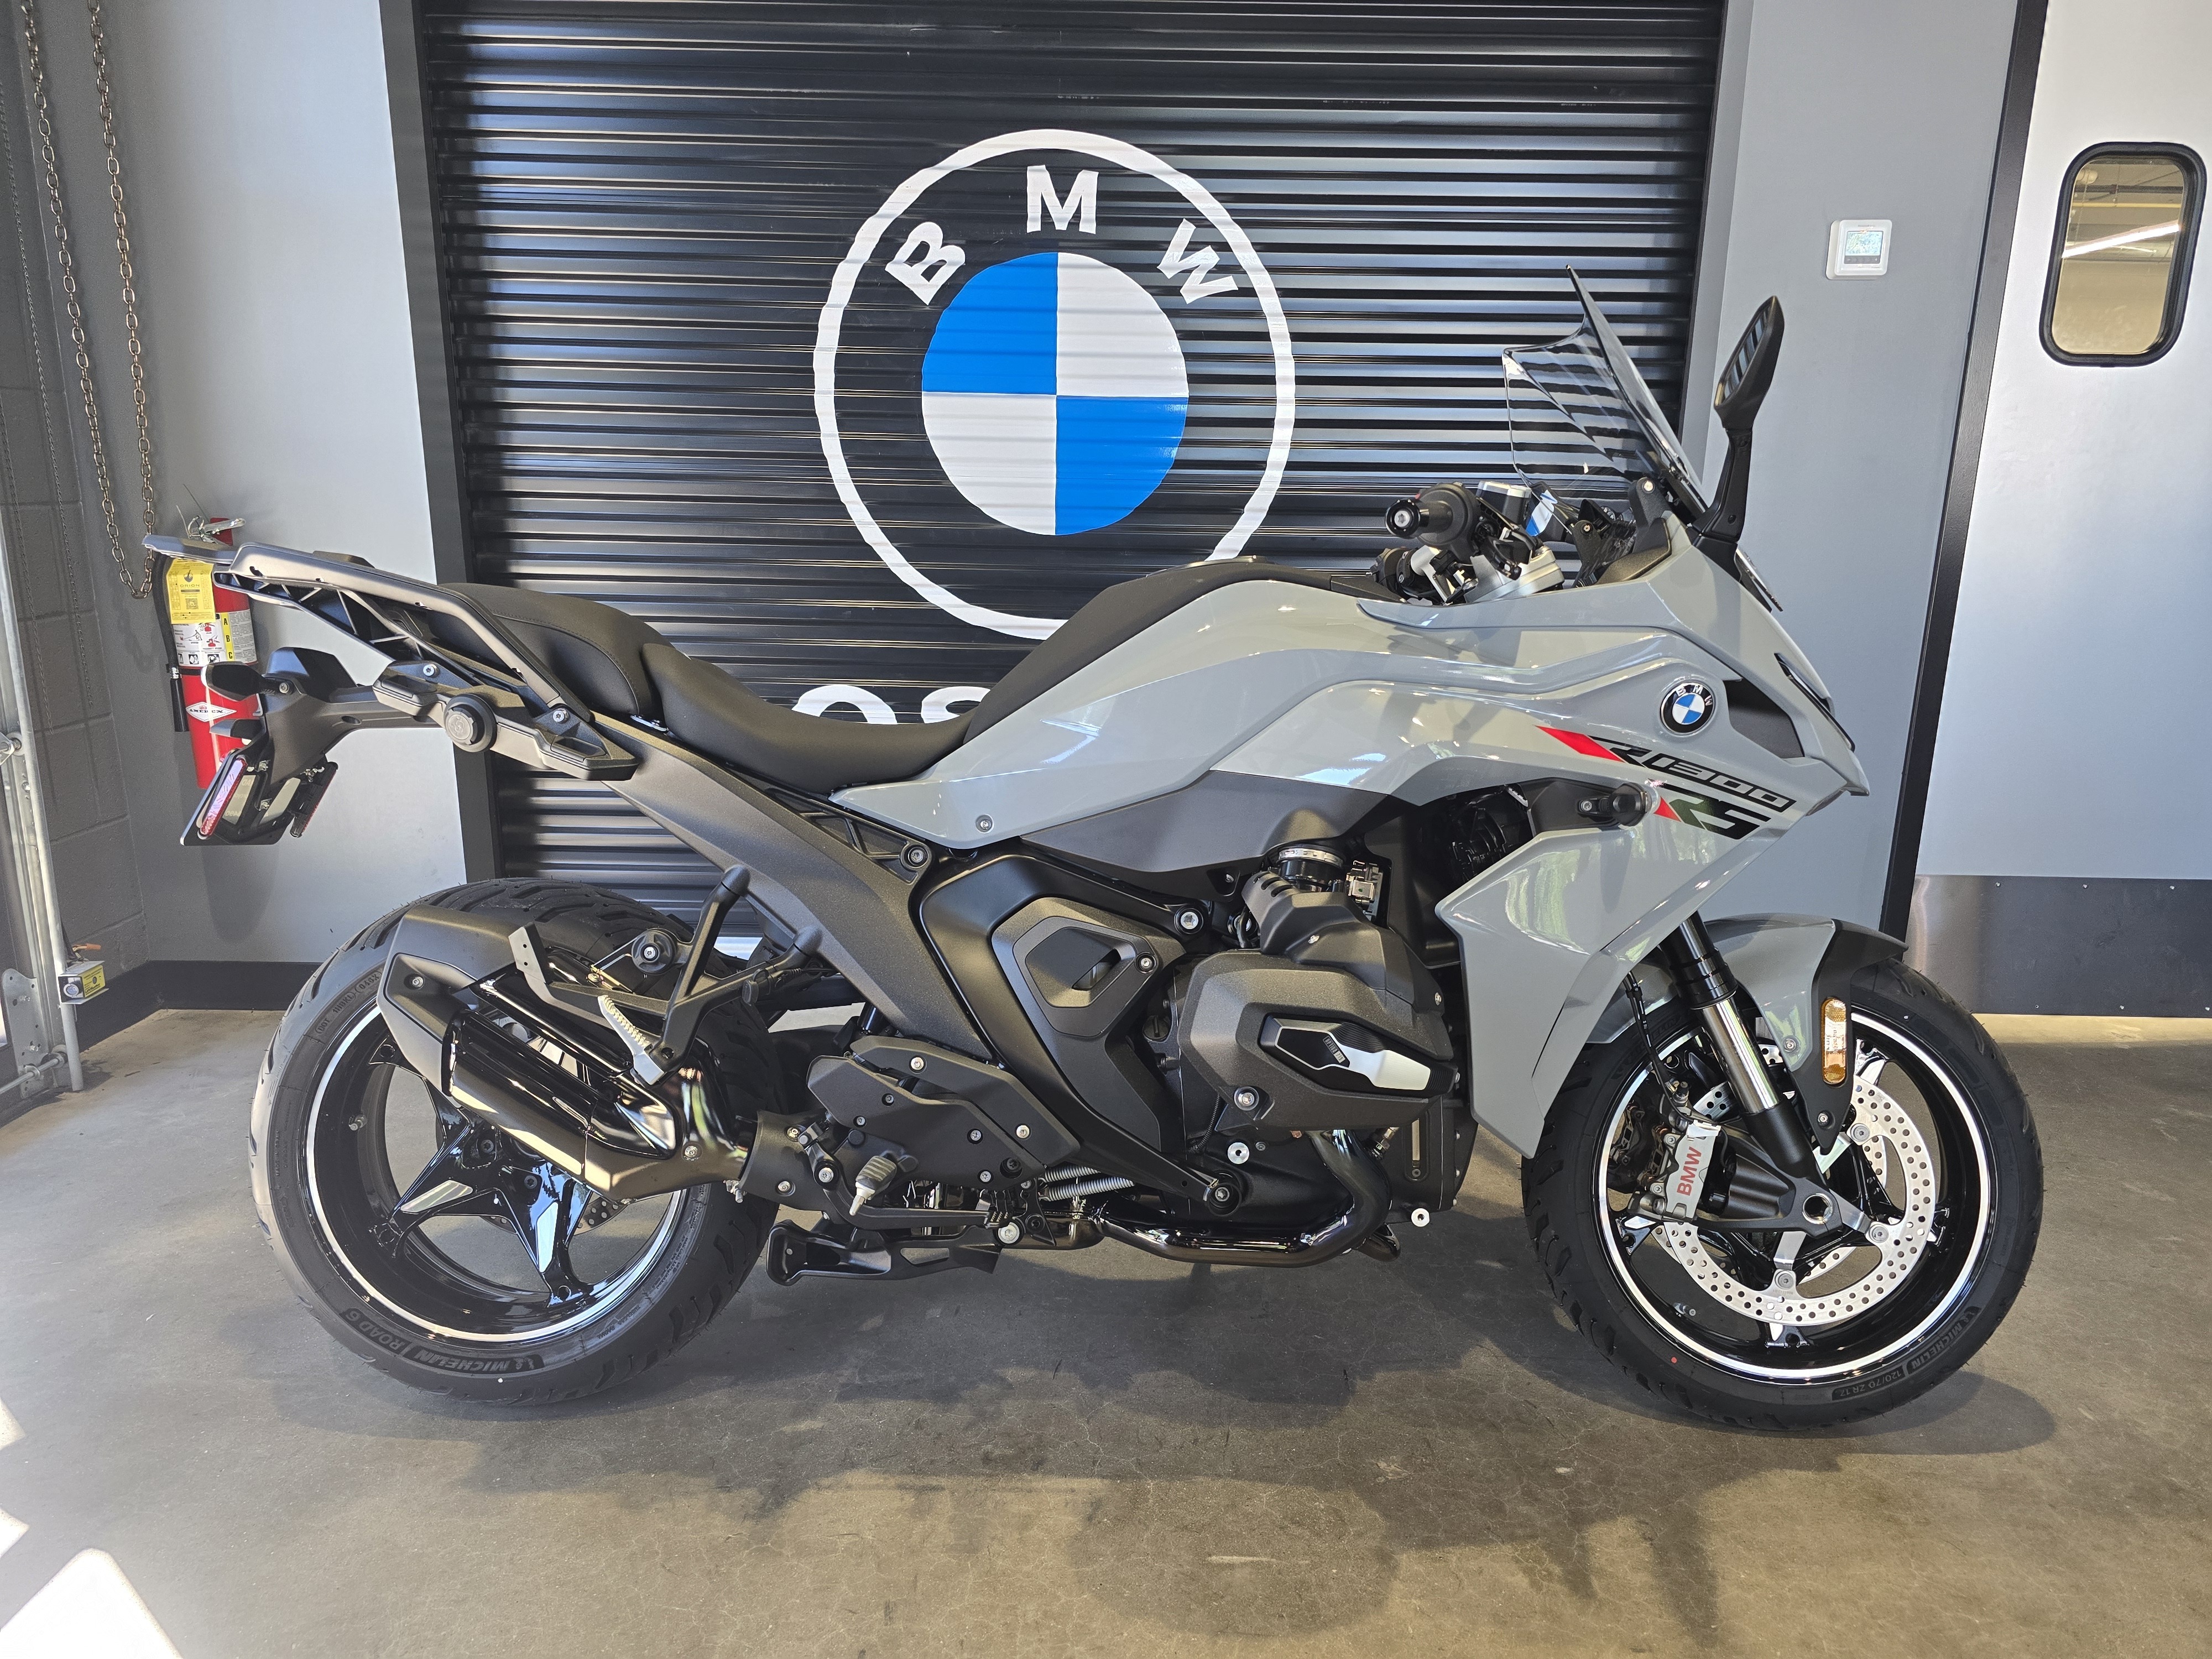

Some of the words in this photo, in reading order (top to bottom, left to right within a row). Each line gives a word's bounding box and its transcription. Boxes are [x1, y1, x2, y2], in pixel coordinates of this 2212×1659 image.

[884, 164, 1239, 305] BMW
[1676, 684, 1714, 707] BMW
[1677, 1146, 1702, 1196] BMW
[346, 1310, 359, 1323] 6
[359, 1319, 401, 1350] ROAD
[1911, 1323, 1963, 1370] MICHELIN
[414, 1349, 510, 1371] MICHELIN
[1853, 1383, 1866, 1395] ZR
[1868, 1370, 1903, 1389] 120/70
[1840, 1387, 1851, 1397] 17
